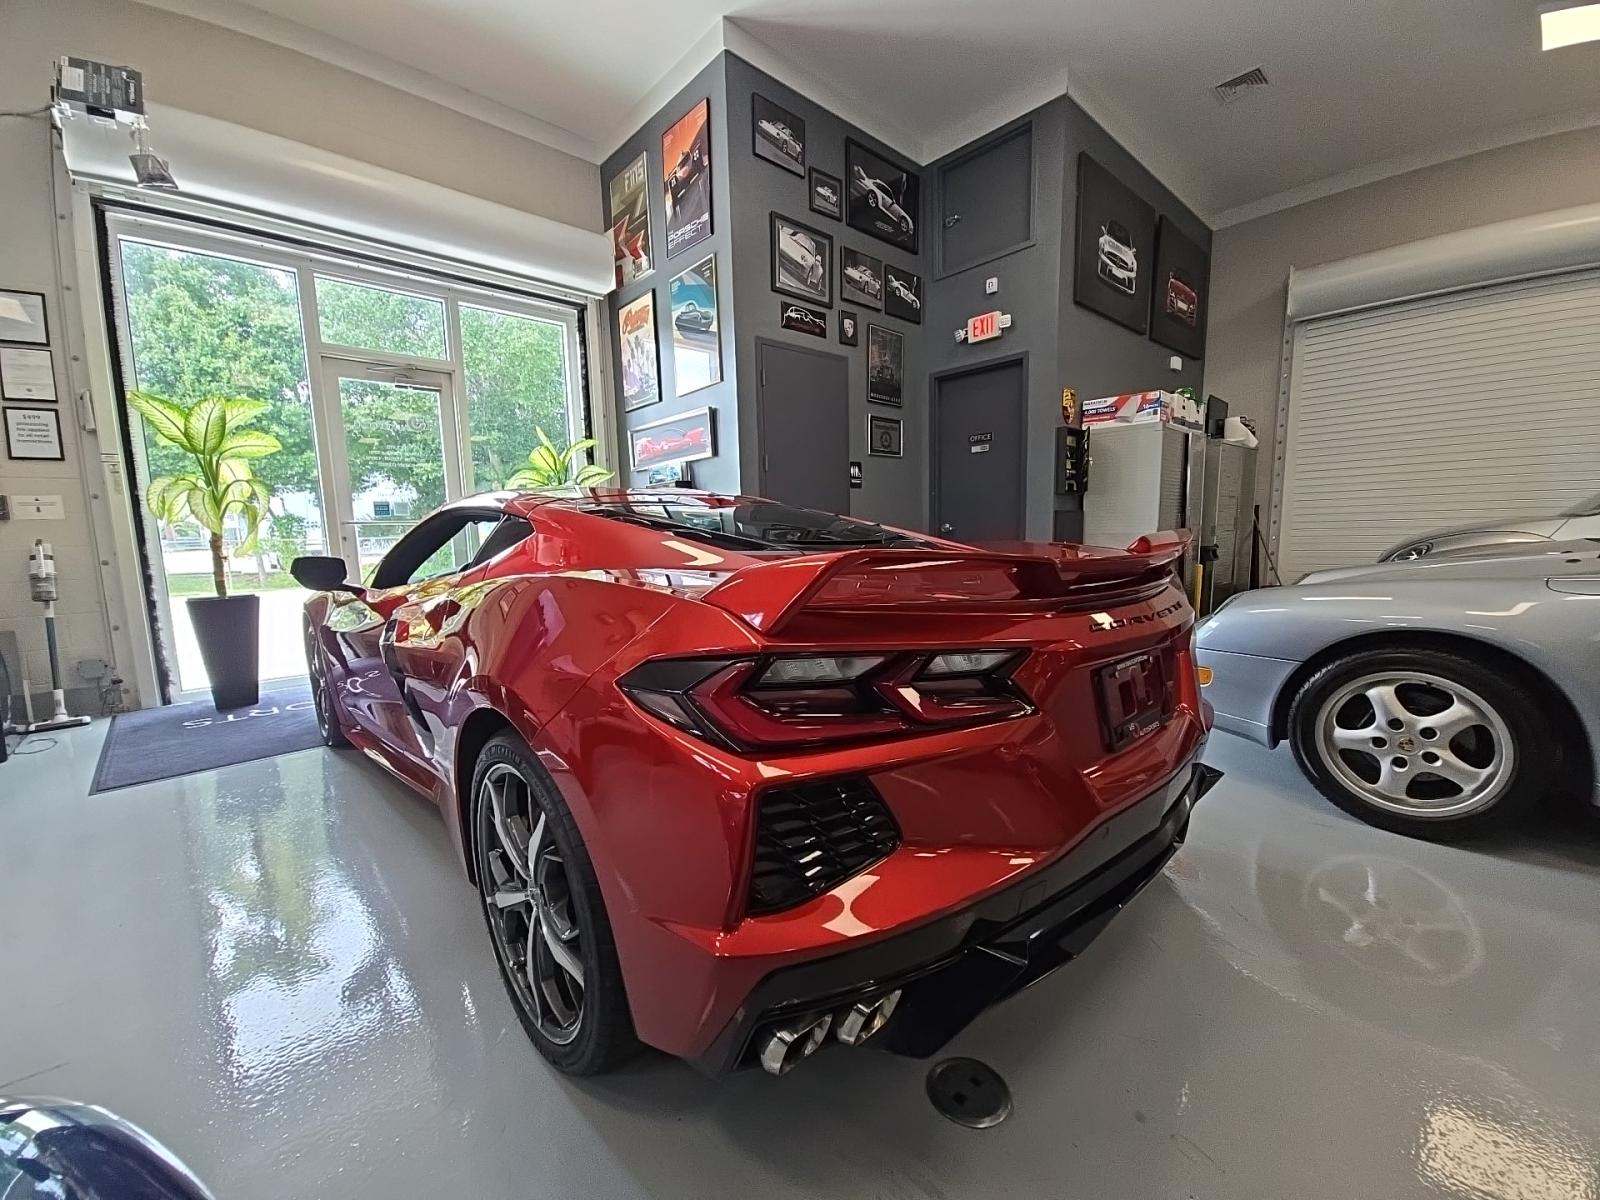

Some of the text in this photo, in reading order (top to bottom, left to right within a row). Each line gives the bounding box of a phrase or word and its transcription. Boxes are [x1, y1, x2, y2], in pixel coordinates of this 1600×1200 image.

[667, 212, 709, 243] PORSCHE
[667, 223, 703, 250] EFFECT
[972, 314, 995, 338] EXIT
[969, 433, 992, 442] OFFICE
